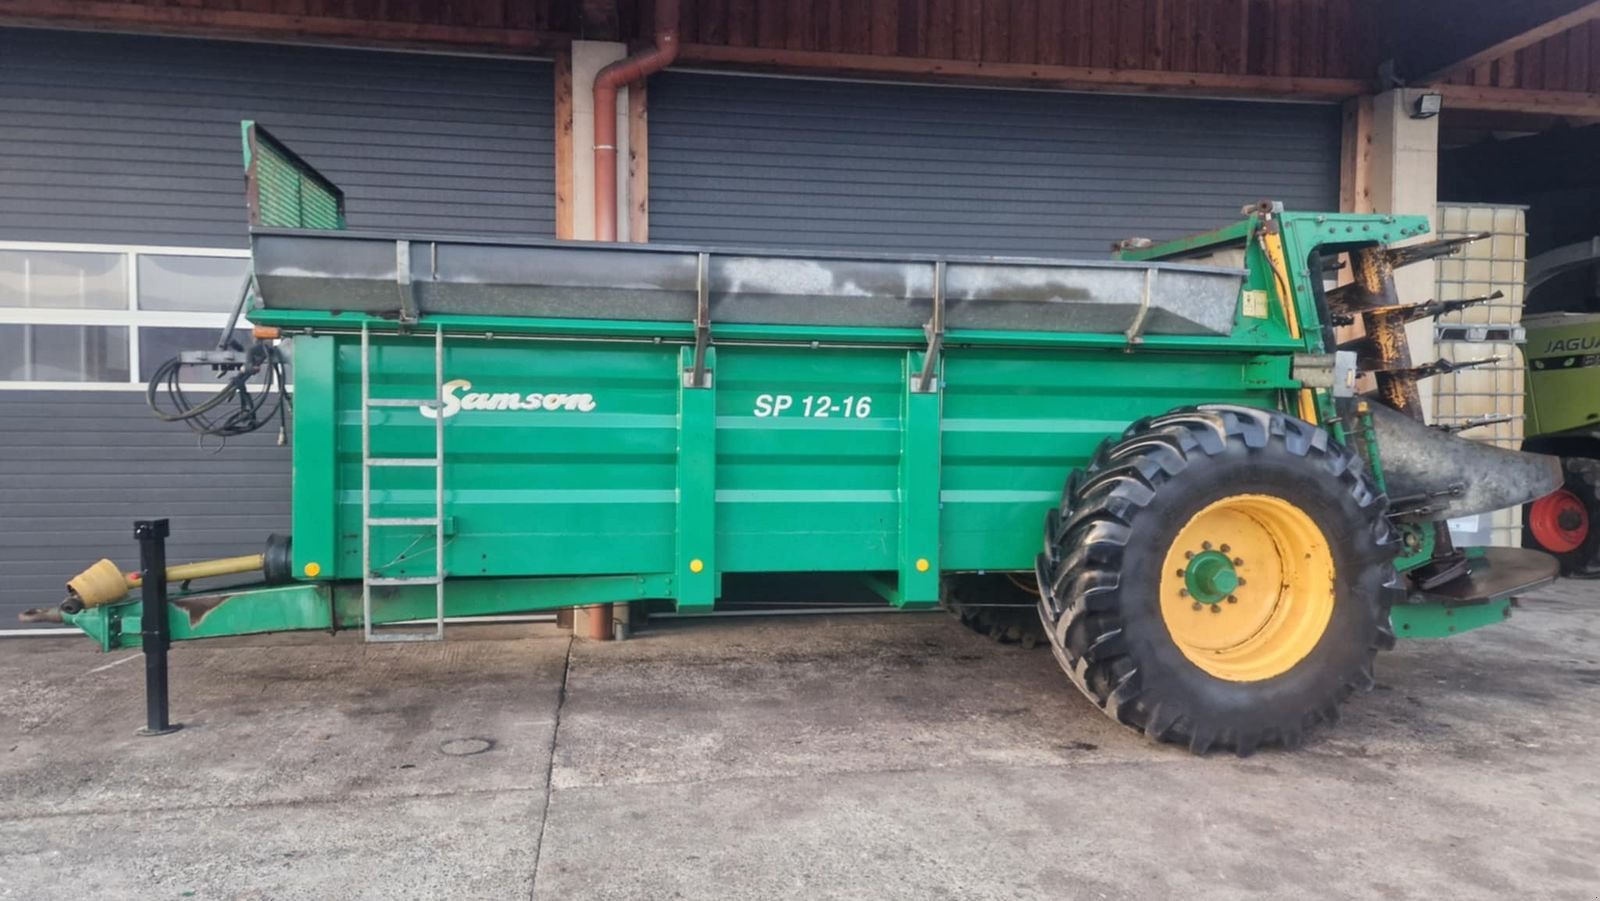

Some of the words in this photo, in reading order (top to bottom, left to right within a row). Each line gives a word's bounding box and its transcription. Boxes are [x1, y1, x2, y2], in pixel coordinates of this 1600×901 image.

[420, 379, 596, 418] Samson
[753, 394, 793, 417] SP
[802, 395, 872, 418] 12-16
